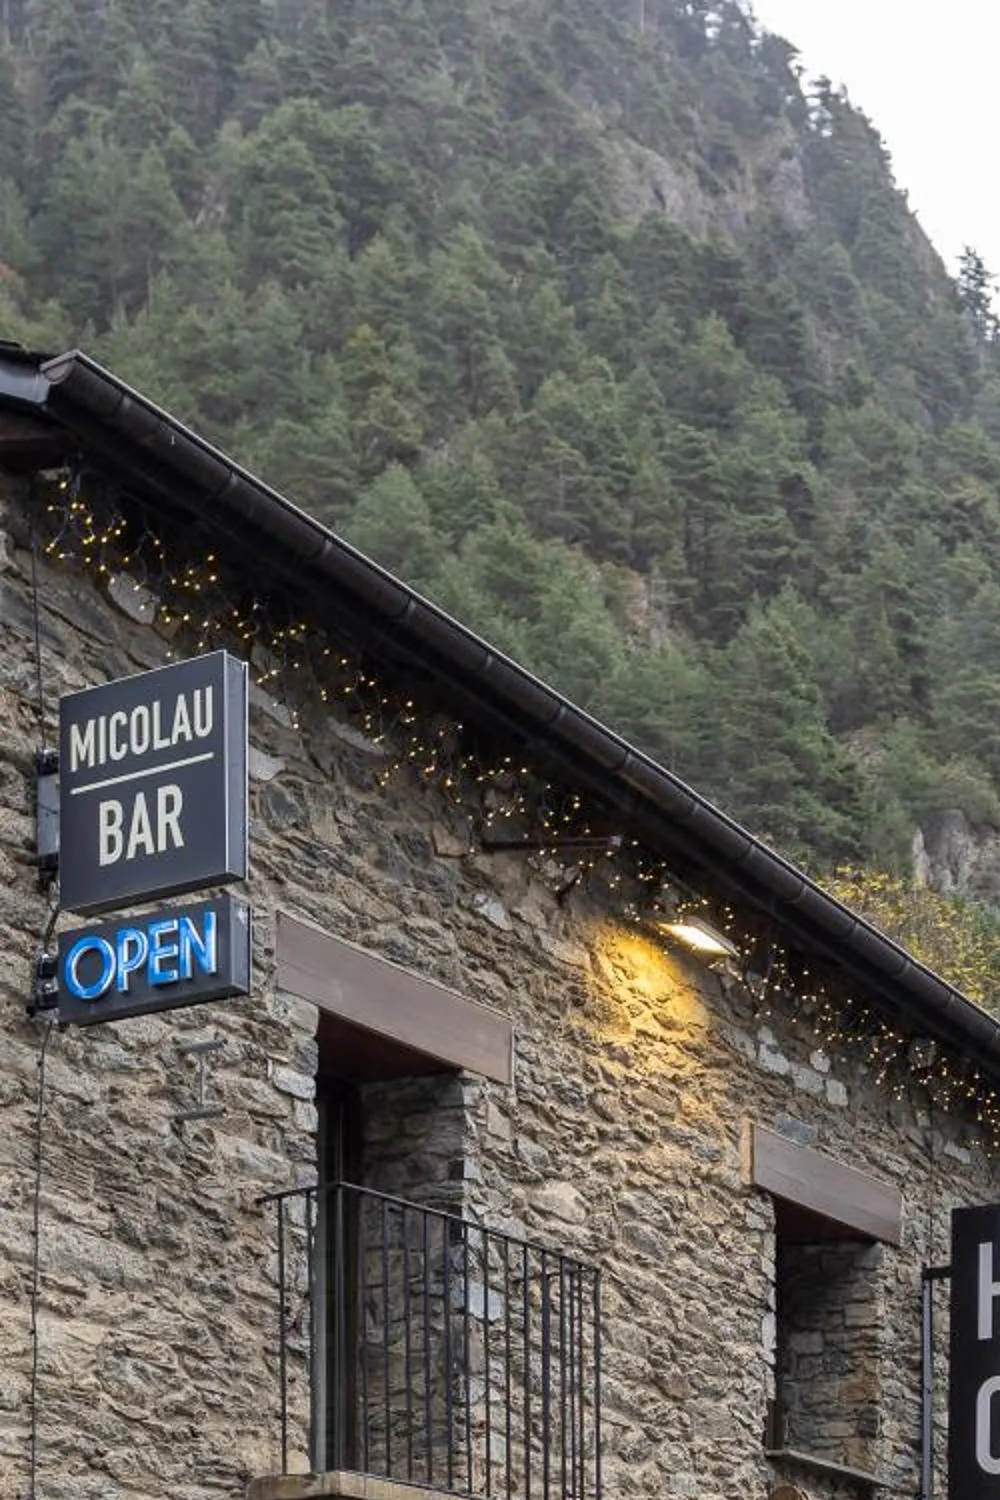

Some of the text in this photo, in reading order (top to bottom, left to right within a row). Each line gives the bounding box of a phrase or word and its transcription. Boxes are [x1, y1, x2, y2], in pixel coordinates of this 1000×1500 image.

[70, 686, 214, 772] MICOLAU
[99, 784, 185, 866] BAR
[64, 911, 217, 999] OPEN
